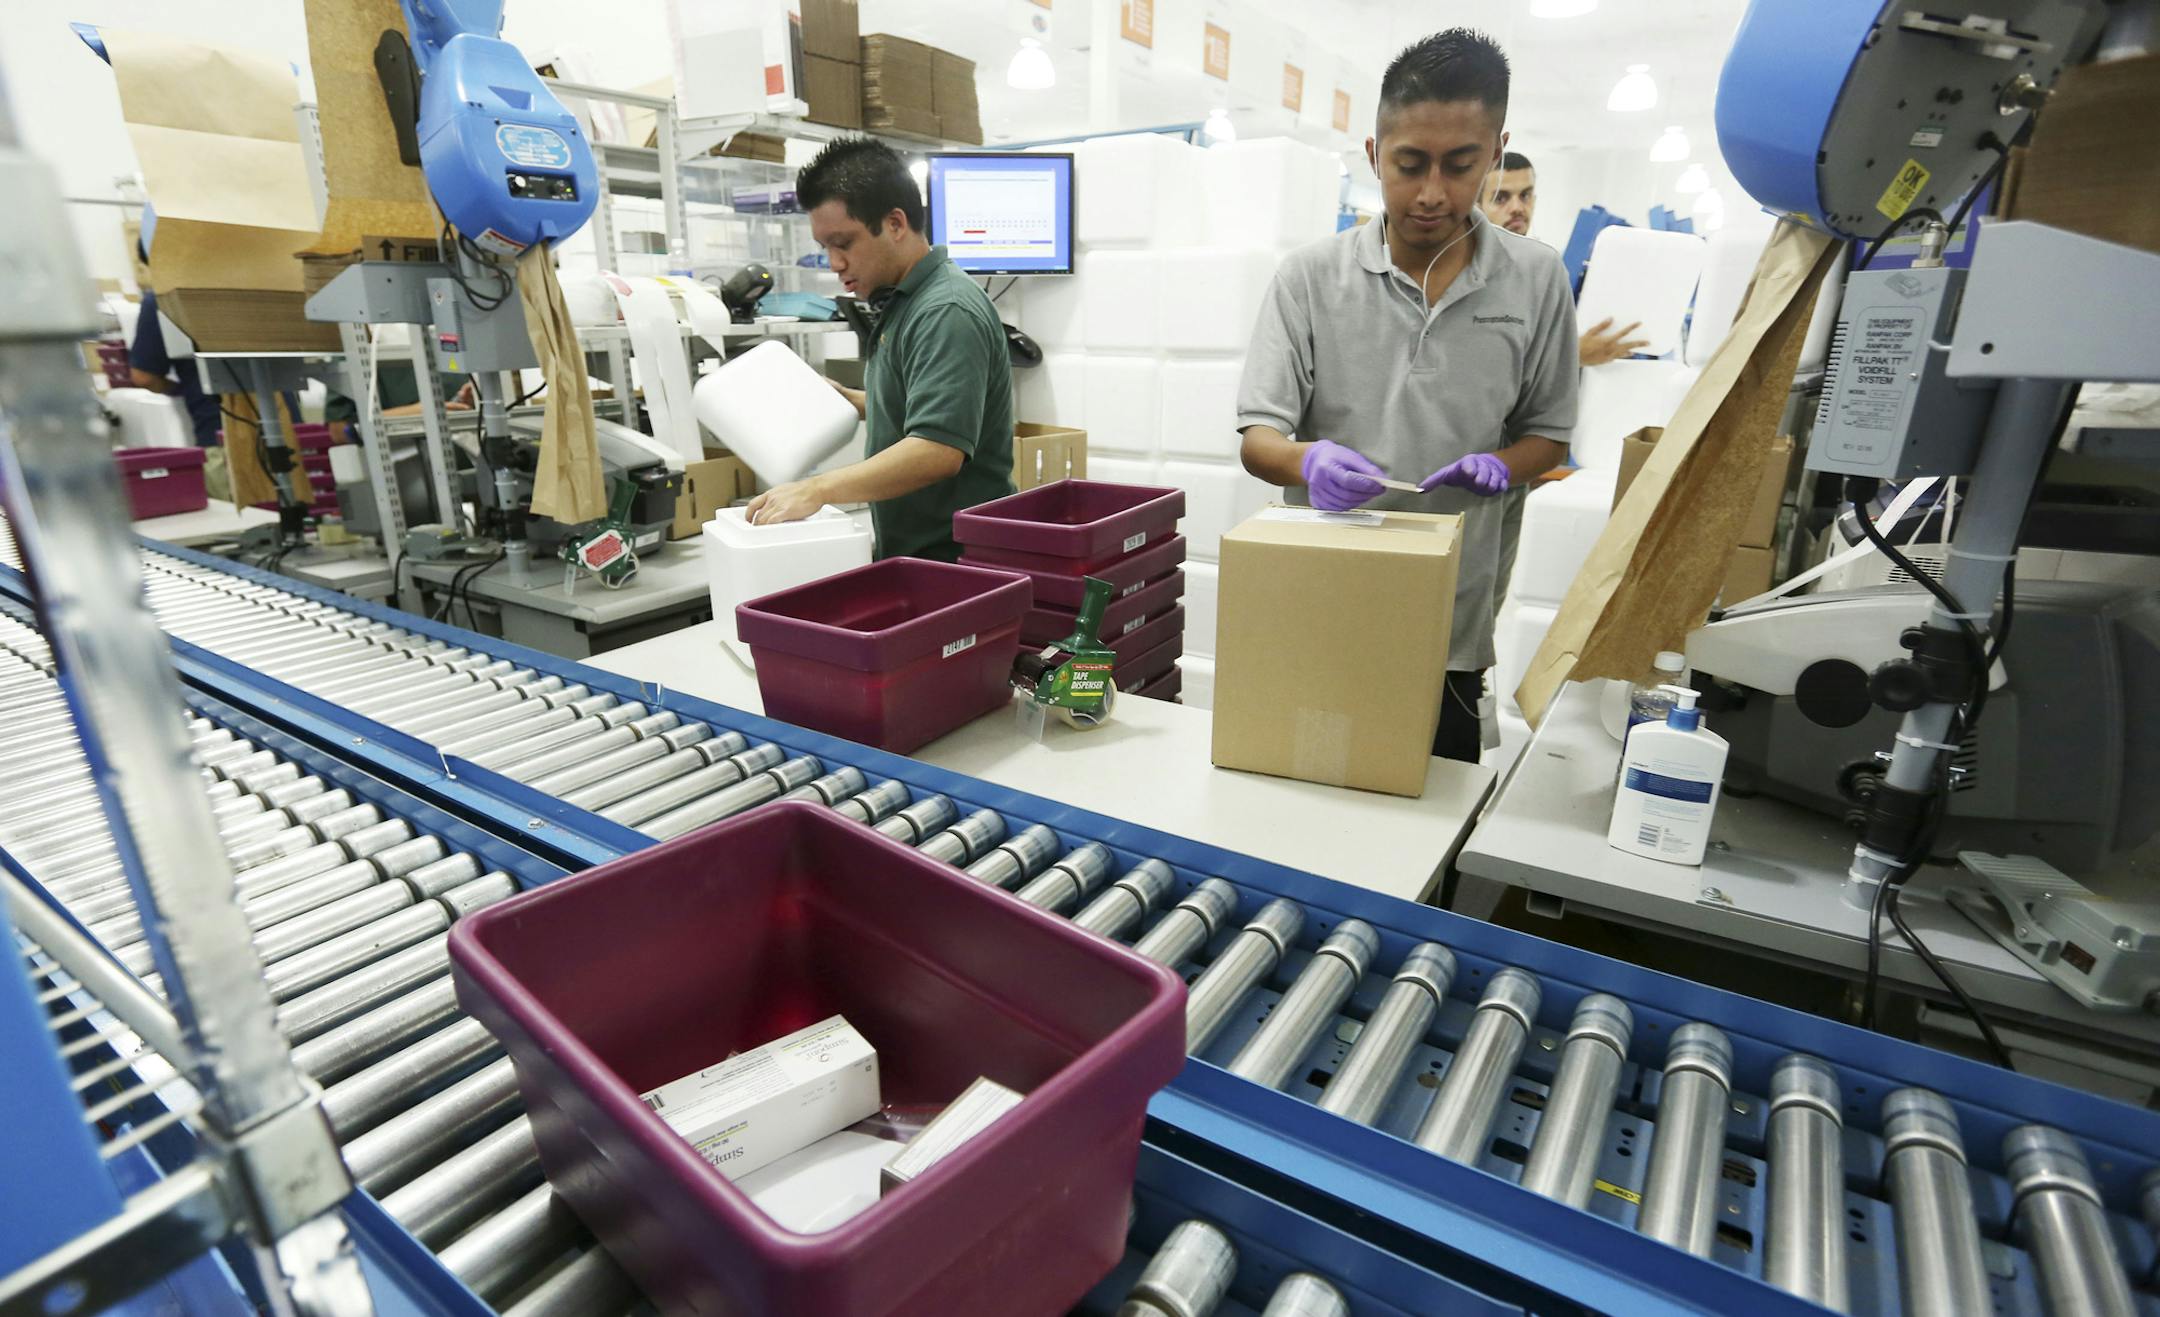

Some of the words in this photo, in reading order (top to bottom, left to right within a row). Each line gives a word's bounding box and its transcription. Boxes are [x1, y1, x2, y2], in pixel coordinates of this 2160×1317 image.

[1903, 166, 1925, 189] OK
[1852, 356, 1888, 365] FILLPAK
[1858, 366, 1897, 375] VOIDFILL
[1857, 375, 1894, 385] SYSTEM
[1072, 671, 1089, 681] TAPE
[1070, 681, 1104, 690] DISPENSER
[710, 1146, 744, 1167] Simp
